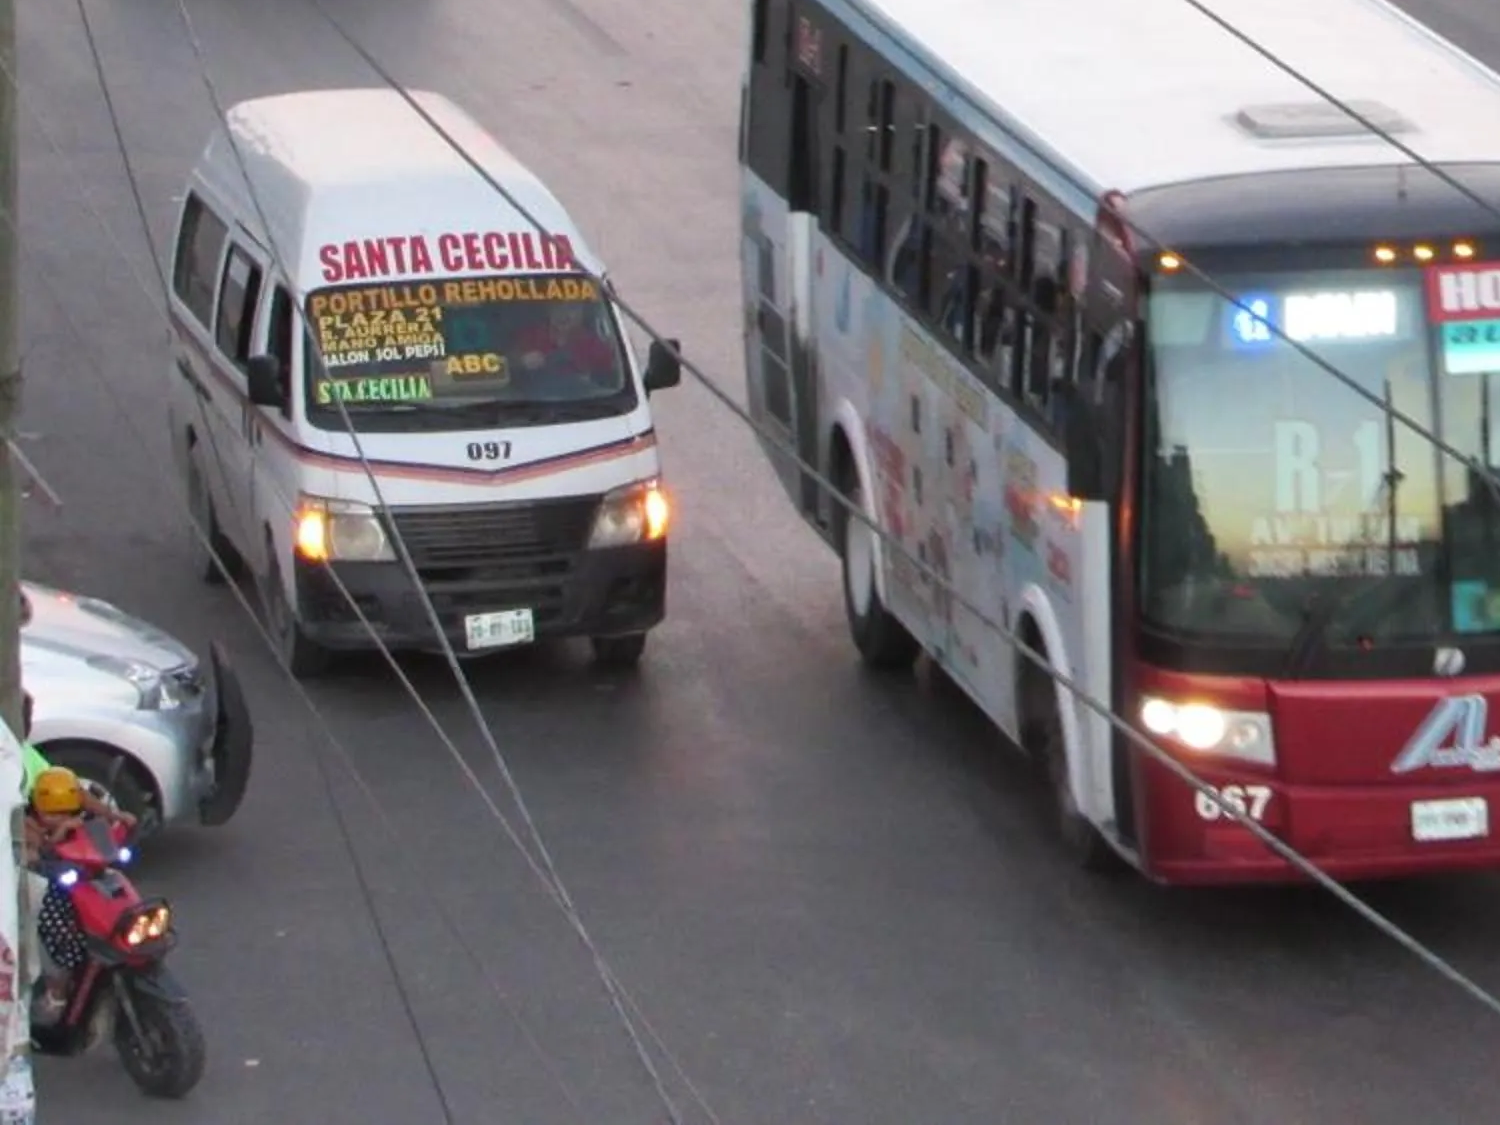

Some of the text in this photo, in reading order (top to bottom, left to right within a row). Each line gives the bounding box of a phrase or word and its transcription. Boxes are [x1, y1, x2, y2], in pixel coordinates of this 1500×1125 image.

[319, 230, 576, 283] SANTA CECILIA
[312, 277, 598, 318] PORTILLO REHOLLADA
[318, 306, 443, 331] PLAZA 21
[446, 354, 501, 375] ABC
[466, 441, 512, 460] 097
[1275, 419, 1381, 513] R-1
